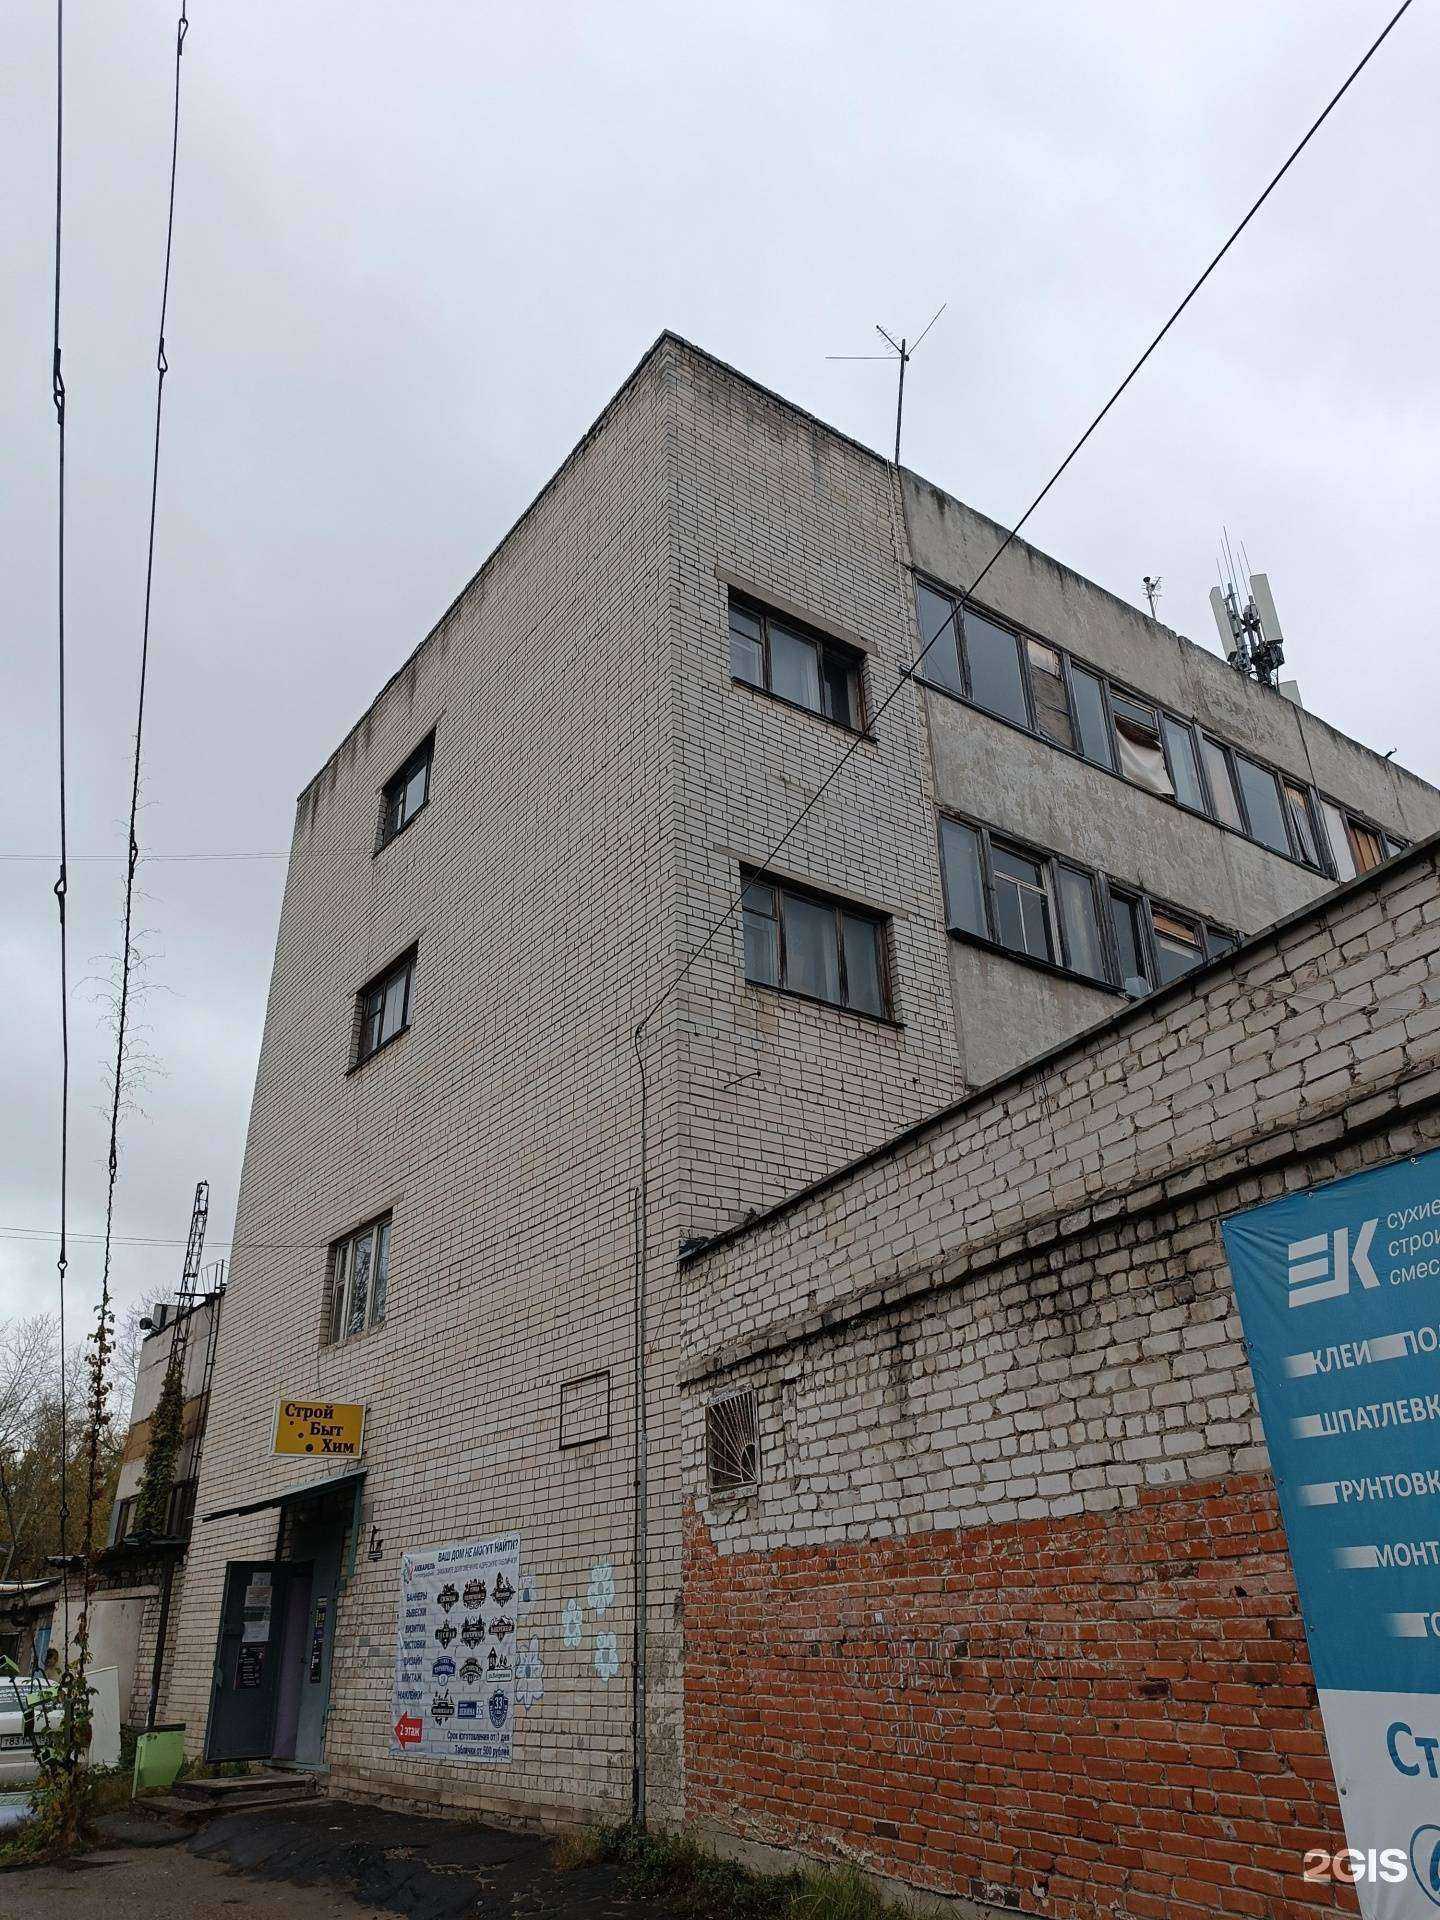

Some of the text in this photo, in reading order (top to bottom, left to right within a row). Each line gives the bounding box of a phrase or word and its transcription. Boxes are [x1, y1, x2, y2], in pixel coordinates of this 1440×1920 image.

[1401, 1324, 1440, 1355] ПО
[285, 1403, 334, 1421] Строй
[310, 1421, 344, 1436] Быт
[321, 1438, 354, 1453] Хим
[438, 1552, 450, 1562] ВАШ
[451, 1548, 465, 1561] ДОМ
[465, 1547, 473, 1558] НЕ
[473, 1543, 494, 1556] МОГУТ
[407, 1592, 428, 1602] БАННЕРЫ
[402, 1672, 423, 1681] МОНТАЖ
[400, 1724, 421, 1737] 2 этаж
[447, 1730, 459, 1742] Срок
